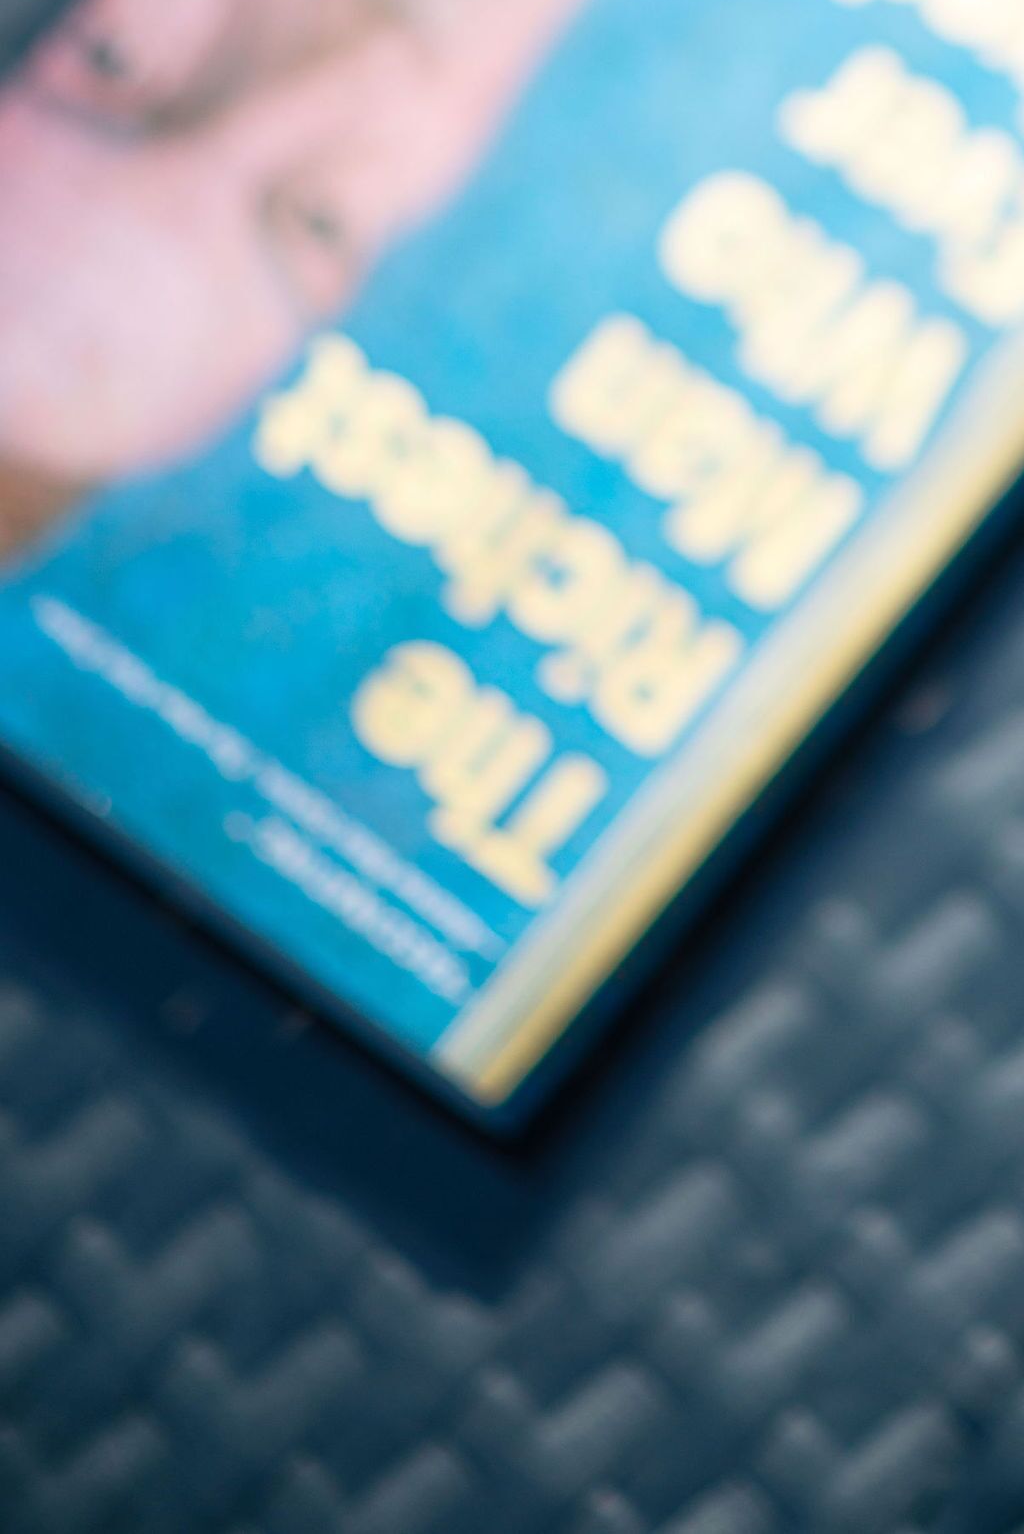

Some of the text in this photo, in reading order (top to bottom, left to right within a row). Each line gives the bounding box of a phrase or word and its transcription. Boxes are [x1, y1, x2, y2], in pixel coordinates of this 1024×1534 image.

[549, 316, 864, 609] Man
[659, 170, 967, 469] Who
[253, 331, 743, 757] Richest
[353, 642, 605, 903] The
